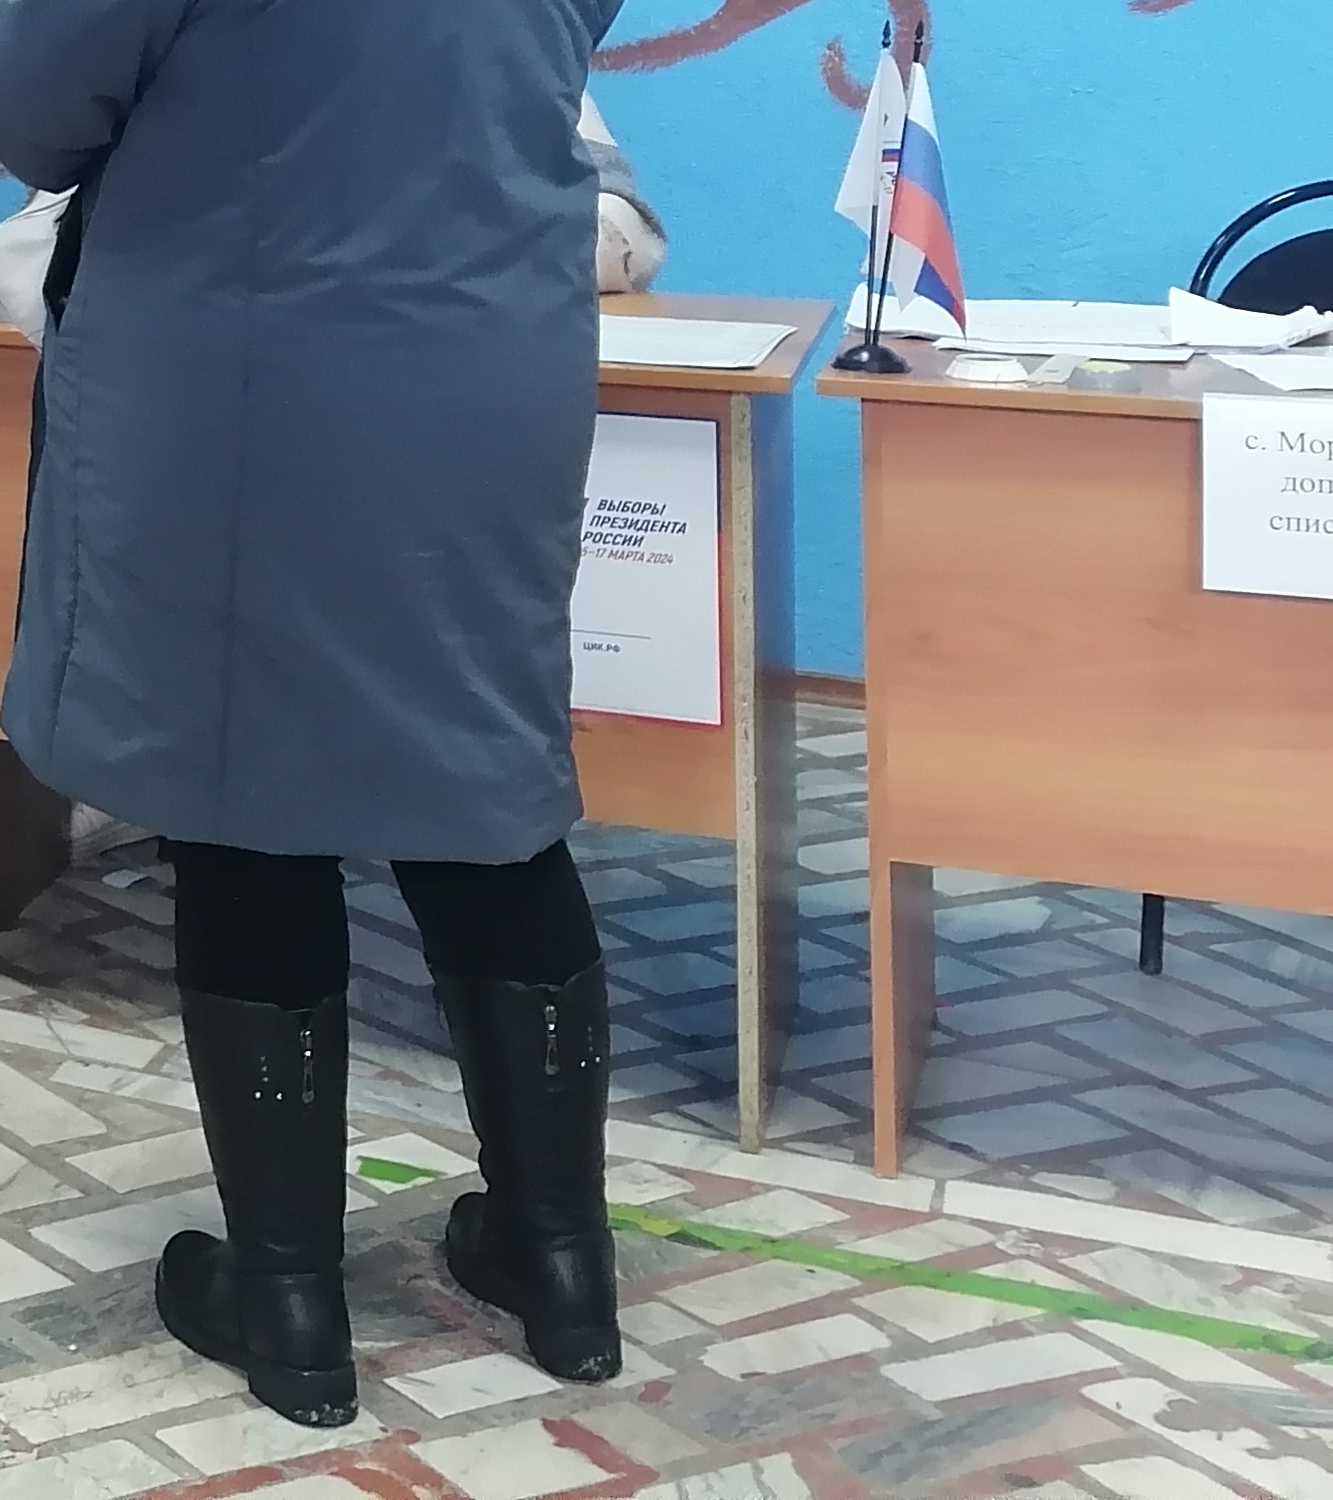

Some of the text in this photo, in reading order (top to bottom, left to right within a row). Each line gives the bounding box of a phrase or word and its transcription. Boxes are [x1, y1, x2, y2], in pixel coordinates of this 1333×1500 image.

[1244, 434, 1267, 451] с.
[1280, 476, 1333, 495] доп
[597, 499, 667, 516] ВЫБОРЫ
[589, 514, 688, 535] ПРЕЗИДЕНТА
[1269, 515, 1333, 535] спис
[582, 531, 645, 548] РОССИИ
[581, 546, 674, 565] 5-17 МАРТА 2024
[583, 641, 621, 653] ЦИК.РФ
